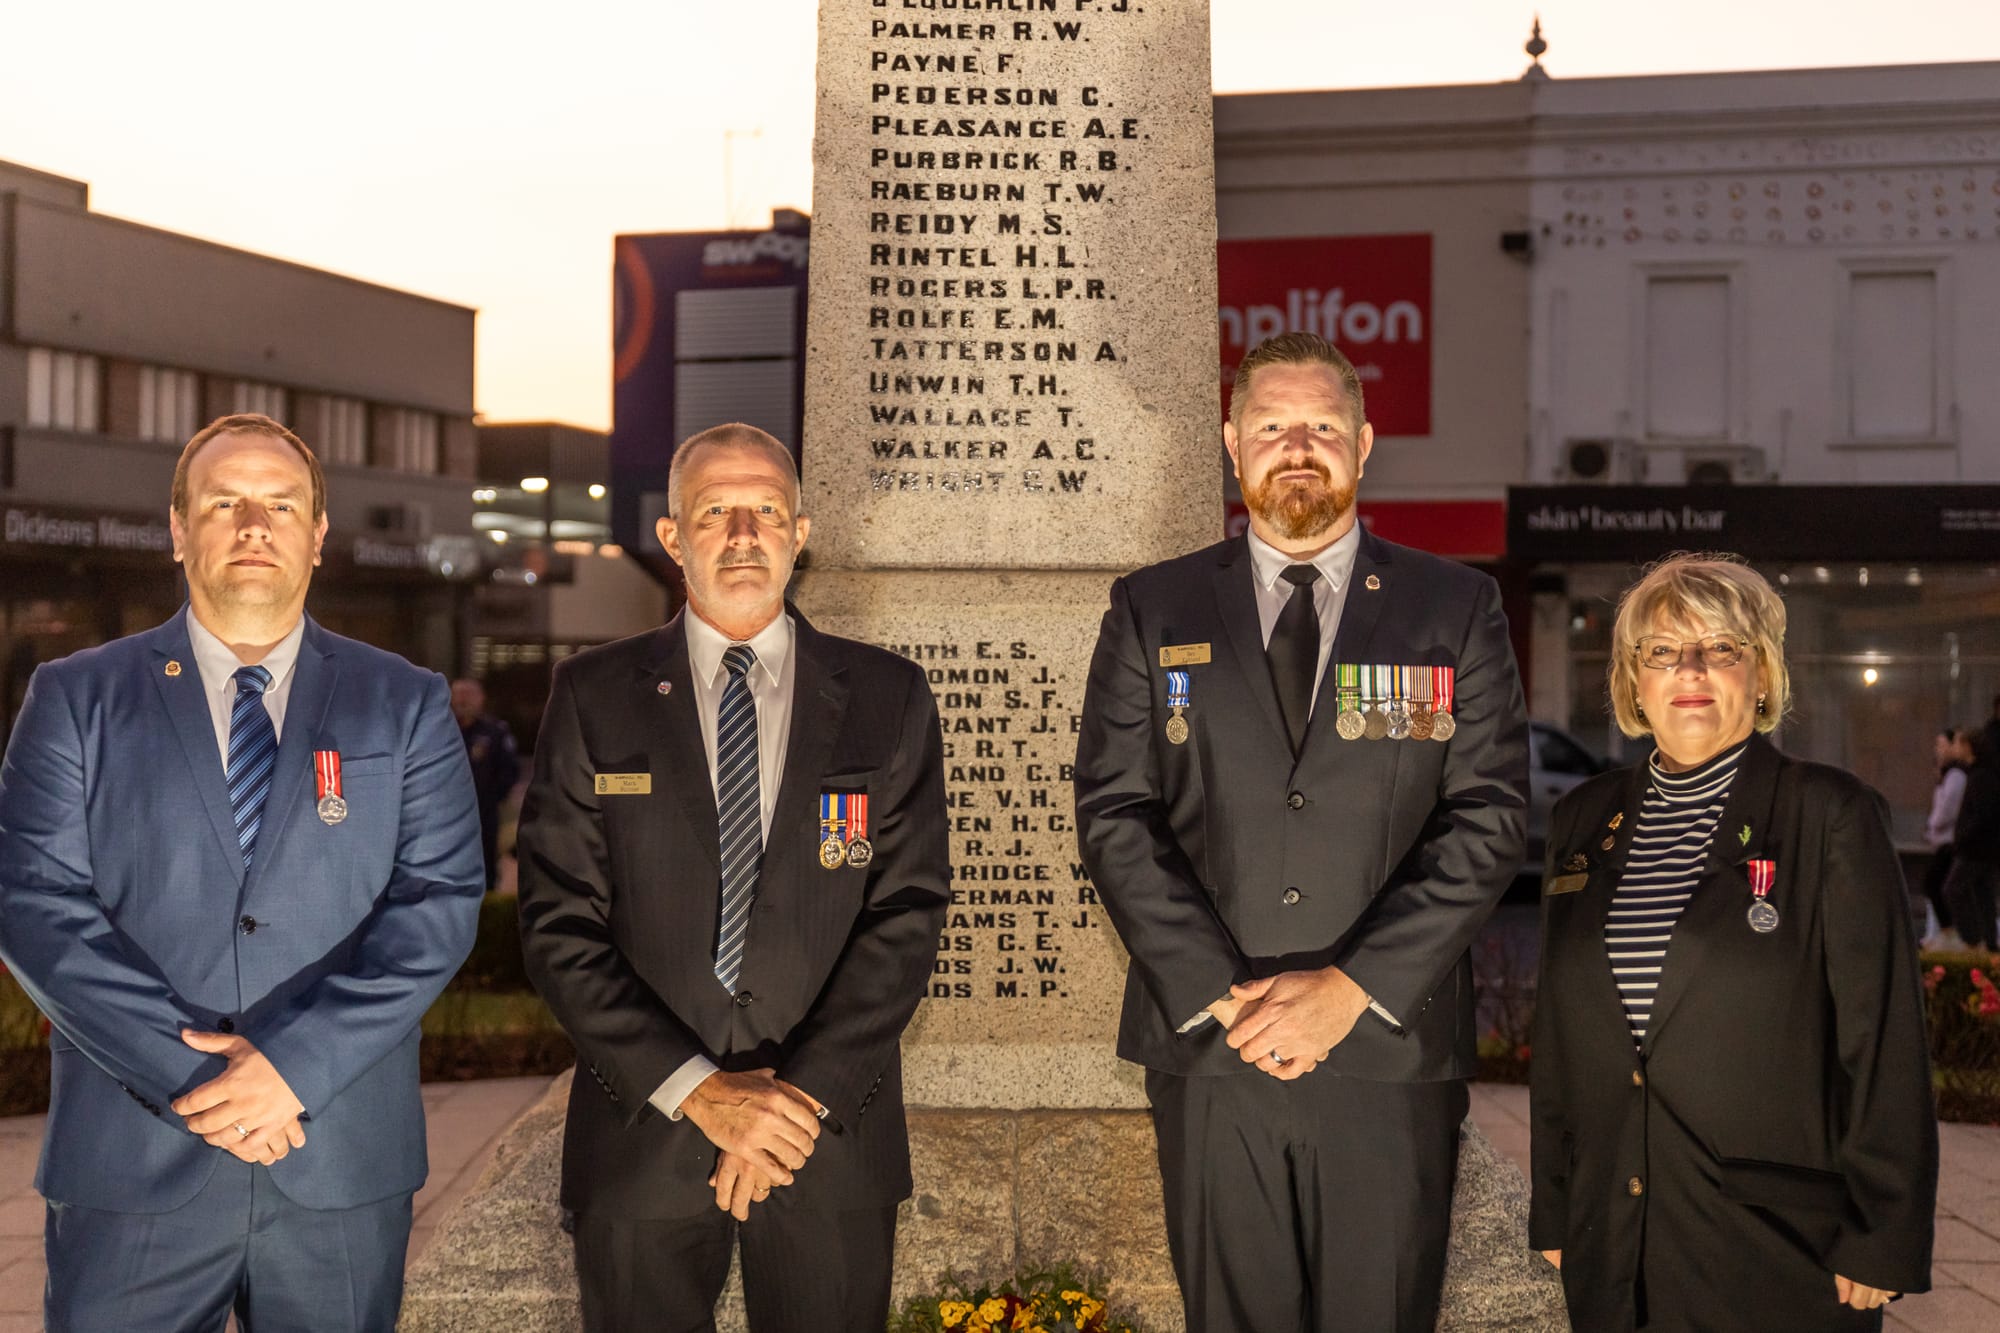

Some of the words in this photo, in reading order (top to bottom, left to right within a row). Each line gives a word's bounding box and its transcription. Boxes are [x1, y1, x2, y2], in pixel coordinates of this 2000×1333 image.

[872, 21, 996, 40] PALMER
[1014, 21, 1090, 40] R.W.
[872, 53, 978, 72] PAYNE
[998, 54, 1021, 73] F.
[872, 84, 1058, 106] PEDERSON
[1082, 87, 1113, 107] C.
[872, 116, 1066, 138] PLEASANCE
[1084, 118, 1150, 139] A.E.
[871, 148, 1040, 170] PURBRICK
[1061, 151, 1131, 171] R.B.
[871, 181, 1025, 201] RAEBURN
[1044, 183, 1113, 203] T.W.
[871, 212, 977, 234] REIDY
[998, 214, 1071, 235] M.S.
[871, 244, 996, 266] RINTEL
[871, 276, 1007, 298] ROGERS
[1023, 279, 1116, 299] L.P.R.
[870, 308, 975, 328] ROLFE
[996, 308, 1064, 329] E.M.
[870, 338, 1076, 361] TATTERSON
[870, 371, 984, 394] UNWIN
[1009, 374, 1068, 396] T.H.
[870, 405, 1032, 426] WALLACE
[1058, 407, 1083, 427] T.
[871, 438, 1007, 459] WALKER
[1032, 438, 1109, 460] A.C.
[870, 469, 1005, 492] WRIGHT
[878, 643, 958, 659] MITH
